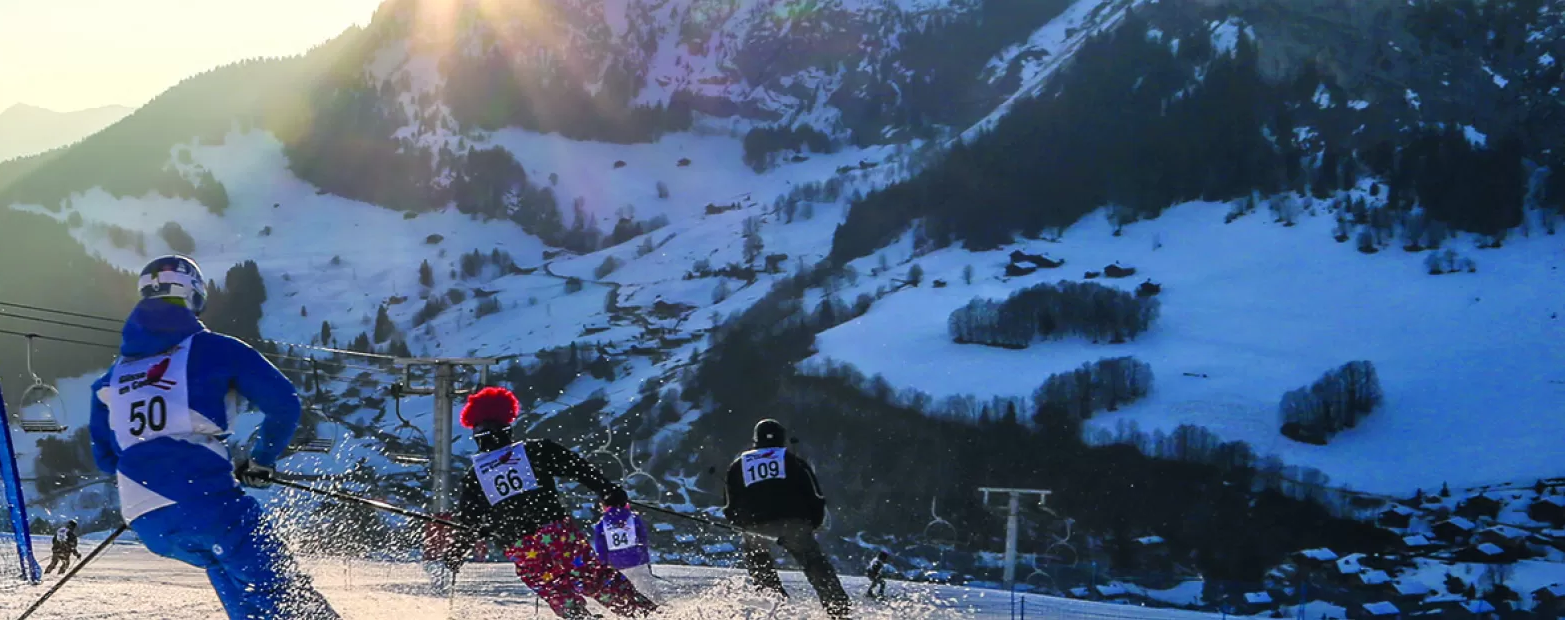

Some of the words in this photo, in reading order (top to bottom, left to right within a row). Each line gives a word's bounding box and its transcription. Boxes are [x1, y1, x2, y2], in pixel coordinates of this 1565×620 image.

[129, 395, 167, 436] 50
[494, 468, 523, 496] 66
[746, 460, 779, 481] 109
[612, 532, 629, 547] 84
